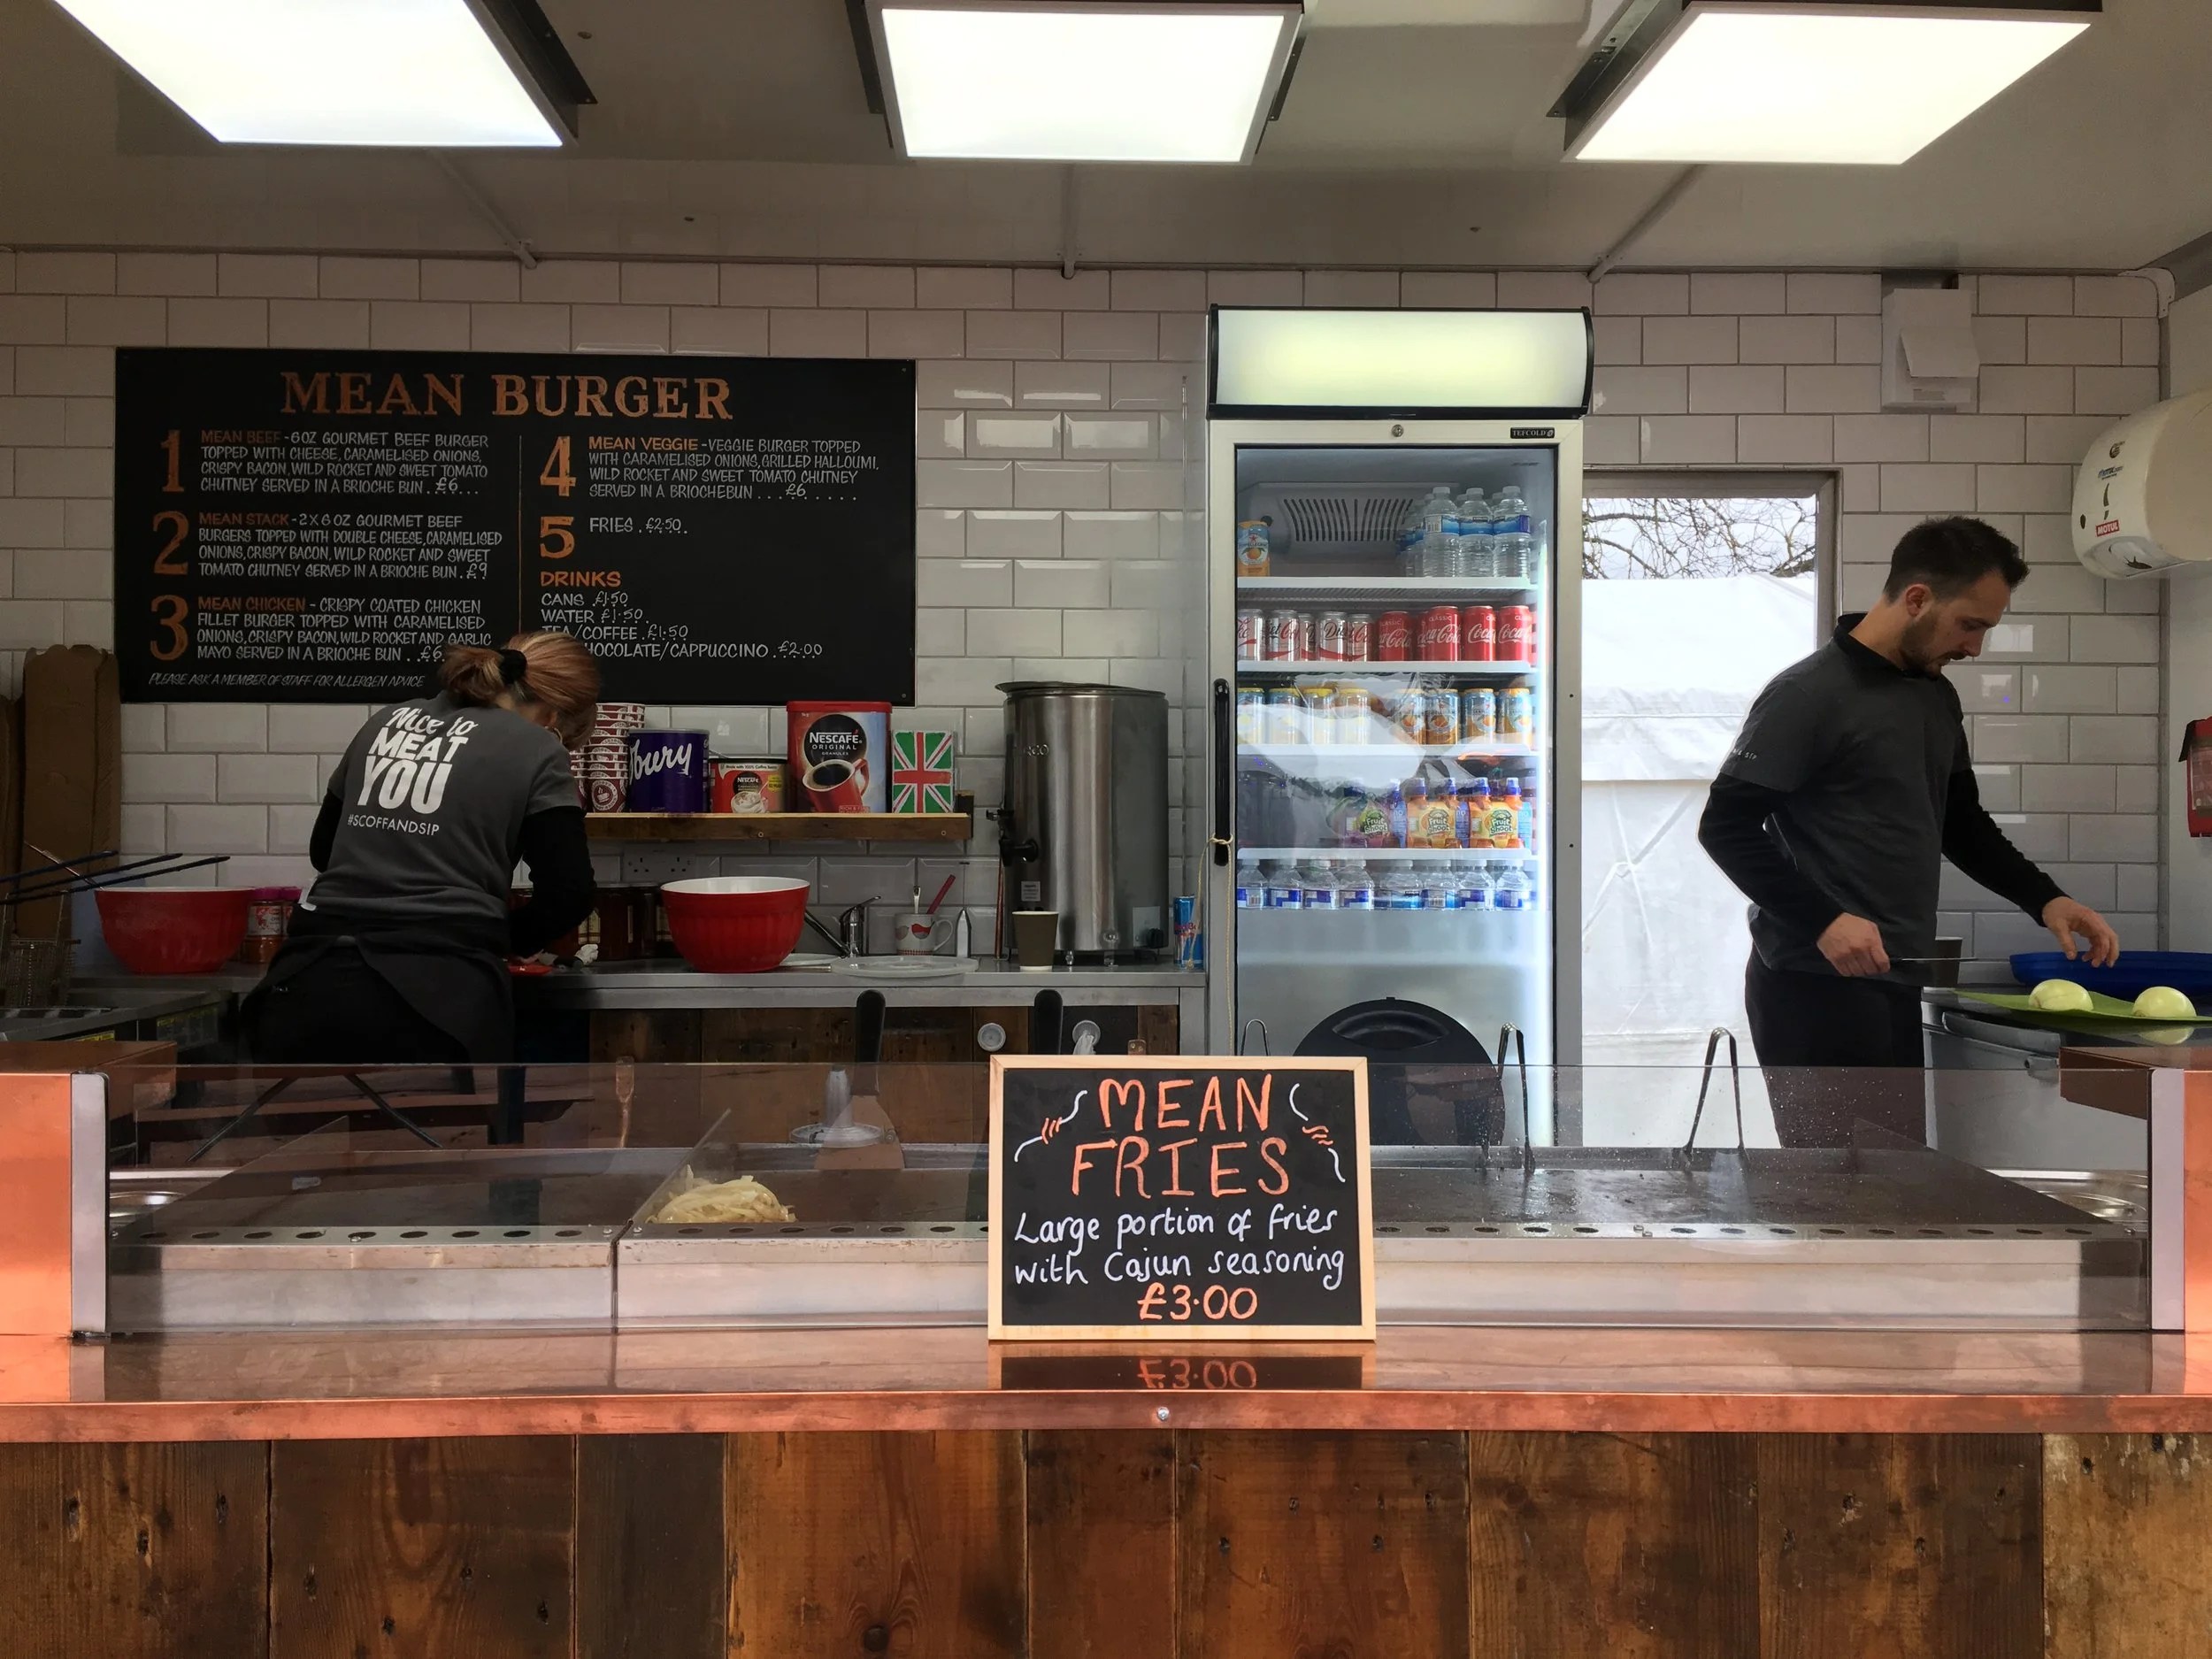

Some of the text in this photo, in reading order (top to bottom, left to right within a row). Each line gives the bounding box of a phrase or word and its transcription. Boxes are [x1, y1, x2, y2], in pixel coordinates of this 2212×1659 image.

[280, 372, 733, 419] MEAN BURGER
[200, 430, 488, 448] MEAN BEEF GOURMET BEEF BURGER
[588, 436, 861, 454] MEAN VEGGIE BURGER TOPPED
[160, 429, 184, 493] 1
[200, 446, 482, 464] TOPPED WITH CHEESE, CARAMELISED ONIONS,
[588, 452, 618, 465] WITH
[623, 452, 711, 466] CARAMELISED
[200, 461, 242, 475] CRISPY
[327, 463, 373, 477] ROCKET
[374, 464, 396, 477] AND
[398, 464, 437, 478] SWEET
[441, 465, 488, 479] TOMATO
[540, 435, 577, 497] 4
[589, 467, 858, 484] WILD ROCKET AND SWEET TOMATO CHUTNEY
[200, 477, 257, 492] CHUTNEY
[262, 478, 310, 493] SERVED
[314, 479, 327, 493] IN
[331, 480, 340, 494] A
[343, 480, 395, 494] BRIOCHE
[398, 480, 423, 495] BUN
[588, 484, 636, 497] SERVED
[641, 484, 652, 497] IN
[656, 484, 664, 498] A
[199, 512, 463, 528] MEAN STACK GOURMET BEEF
[589, 517, 634, 533] FRIES
[152, 511, 189, 575] 2
[198, 528, 251, 542] BURGERS
[256, 529, 296, 543] TOPPED
[300, 530, 329, 543] WITH
[334, 530, 377, 544] DOUBLE
[539, 516, 575, 559] 5
[289, 546, 332, 561] BACON,
[334, 547, 365, 561] WILD
[368, 548, 416, 562] ROCKET
[418, 549, 443, 562] AND
[447, 549, 491, 563] SWEET
[198, 562, 244, 577] TOMATO
[248, 563, 301, 577] CHUTNEY
[304, 564, 350, 578] SERVED
[354, 565, 365, 578] IN
[369, 565, 378, 578] A
[380, 565, 429, 579] BRIOCHE
[433, 565, 457, 579] BUN
[540, 570, 622, 588] DRINKS
[197, 595, 481, 615] MEAN CHICKEN CRISPY COATED CHICKEN
[541, 592, 585, 607] CANS
[197, 612, 486, 630] FILLET BURGER TOPPED WITH CARAMELISED
[541, 609, 595, 624] WATER
[150, 594, 188, 661] 3
[448, 633, 492, 646] GARLIC
[197, 646, 232, 659] MAYO
[235, 646, 284, 660] SERVED
[288, 647, 300, 660] IN
[303, 647, 314, 661] A
[317, 647, 372, 661] BRIOCHE
[375, 647, 402, 662] BUN
[584, 641, 769, 662] HOCOLATE/CAPPUCCINO
[149, 672, 425, 687] PLEASE ASK A MEMBER OF STAFF FOR ALLERGEN ADVICE
[385, 707, 479, 737] Nice to
[368, 727, 469, 762] MEAT
[357, 756, 453, 815] YOU
[348, 814, 440, 836] #SCOFFANDSIP
[1097, 1073, 1272, 1133] MEAN
[1071, 1136, 1288, 1199] FRIES
[1014, 1202, 1338, 1256] Large portion of fries
[1014, 1246, 1345, 1291] with Cajun seasoning
